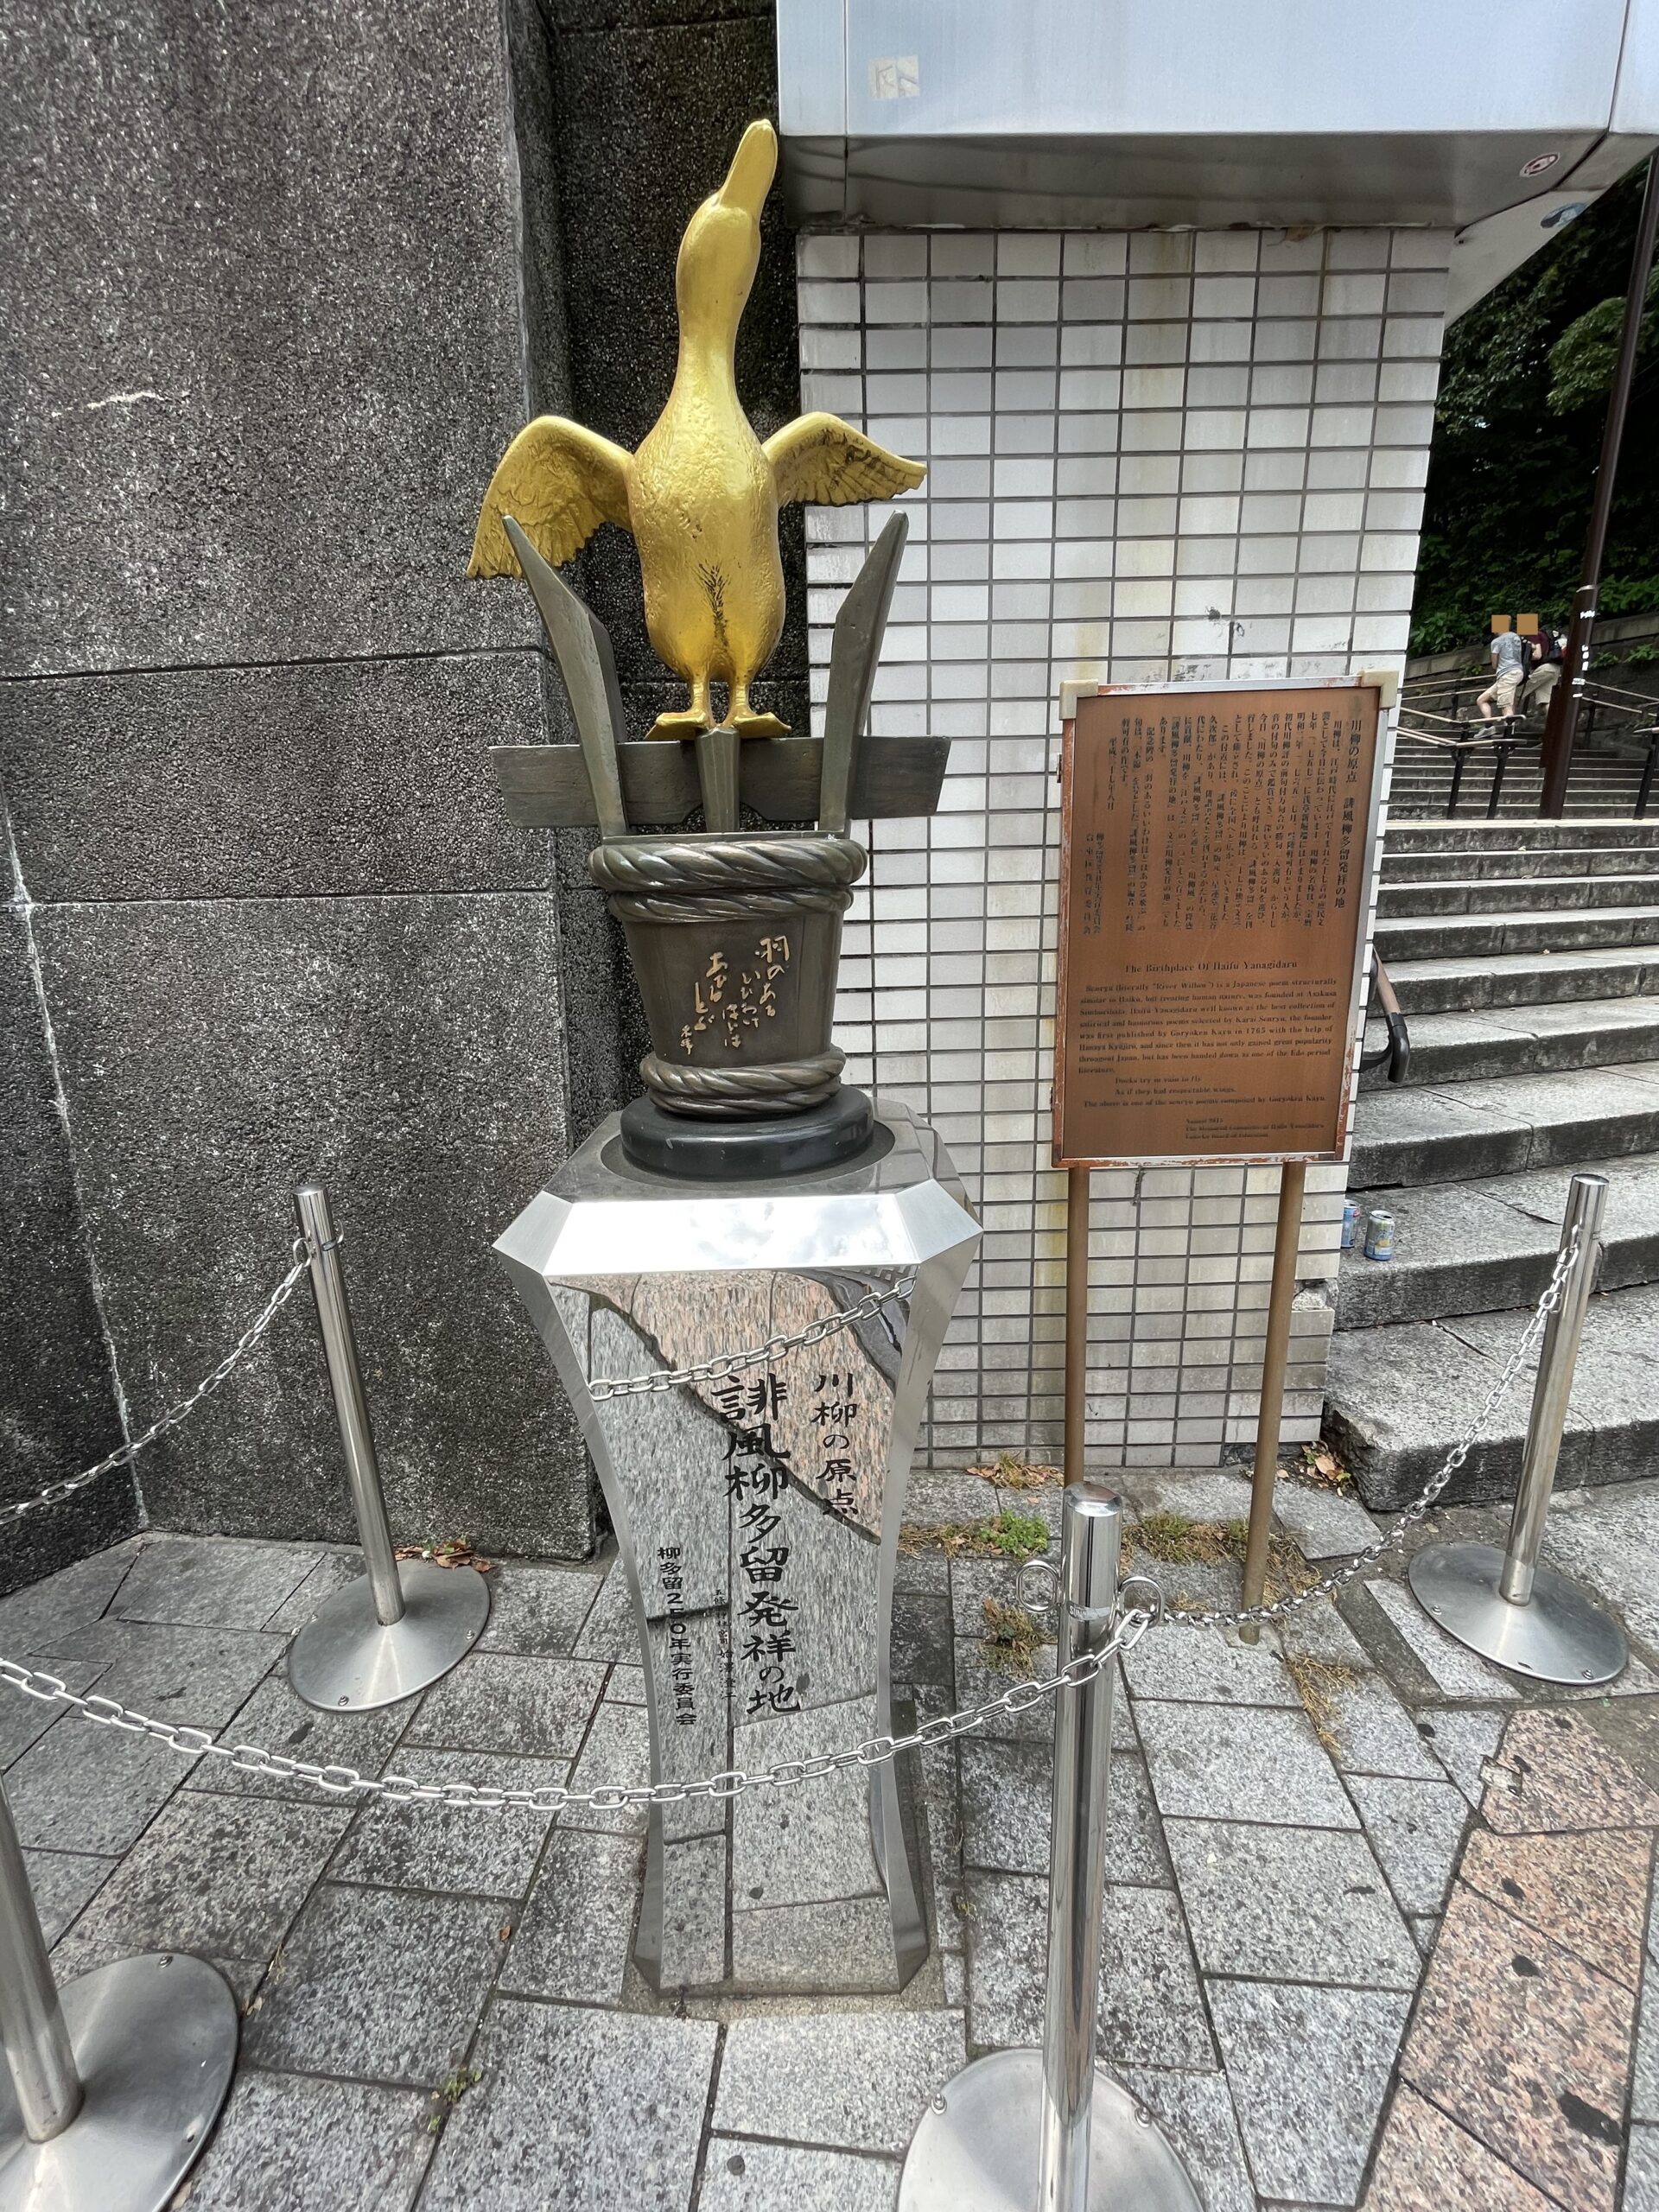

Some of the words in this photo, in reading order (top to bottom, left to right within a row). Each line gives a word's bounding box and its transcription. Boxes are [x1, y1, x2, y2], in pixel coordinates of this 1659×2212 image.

[1125, 963, 1142, 975] The
[1145, 962, 1195, 974] Birthplace
[1243, 958, 1298, 970] Yanagidaru
[1231, 979, 1266, 988] Japanese
[1245, 1026, 1266, 1035] 1765
[1268, 1025, 1287, 1034] with
[810, 1372, 859, 1516] 川柳の原点
[711, 1372, 801, 1715] 誹風柳多留発祥の地
